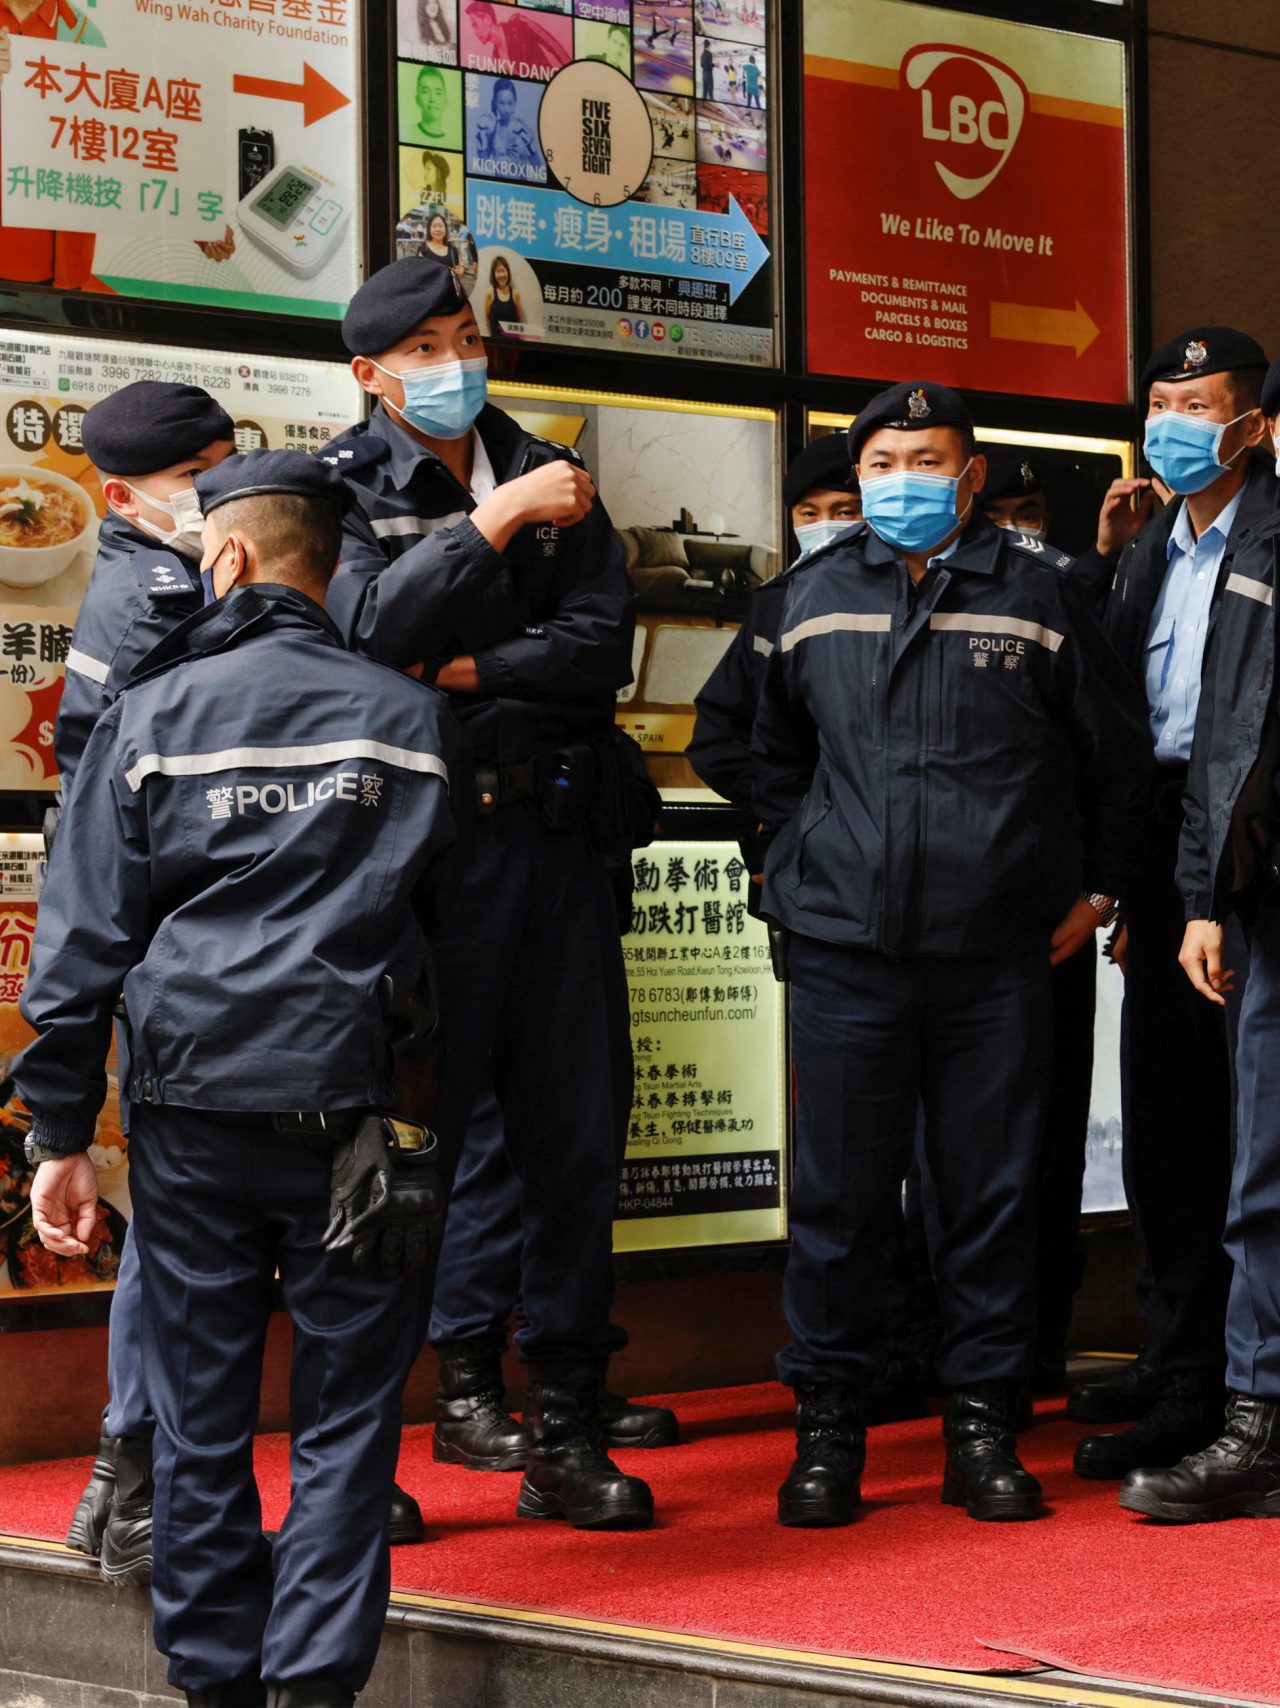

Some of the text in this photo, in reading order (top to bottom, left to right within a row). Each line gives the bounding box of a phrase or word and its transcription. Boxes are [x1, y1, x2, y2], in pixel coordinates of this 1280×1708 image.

[136, 0, 348, 47] Wing Wah Charity Foundation
[467, 53, 516, 76] FUNKY
[24, 56, 202, 122] 本大廈A座
[582, 98, 611, 120] FIVE
[922, 89, 1009, 150] LBC
[582, 118, 610, 138] SIX
[50, 115, 178, 172] 7樓12室
[582, 136, 611, 157] SEVEN
[472, 157, 547, 180] KICKBOXING
[582, 154, 611, 176] EIGHT
[564, 176, 571, 190] 7
[623, 185, 630, 198] 5
[690, 225, 745, 251] 直行B座
[880, 212, 1053, 256] We Like To Move It
[690, 246, 748, 272] 8樓09室
[829, 269, 967, 297] PAYMENTS & REMITTANCE
[543, 285, 622, 309] 每月約 200
[627, 292, 728, 320] 課堂不同時段選擇
[861, 291, 967, 314] DOCUMENTS & MAIL
[875, 310, 967, 332] PARCELS & BOXES
[865, 328, 968, 350] CARGO & LOGISTICS
[72, 381, 94, 393] 6918
[101, 365, 130, 380] 3996
[134, 368, 161, 381] 7282
[203, 376, 231, 389] 6226
[267, 384, 288, 395] 3996
[291, 386, 311, 397] 7276
[285, 424, 331, 440] 優惠食品
[969, 637, 1025, 655] POLICE
[638, 733, 664, 743] SPAIN
